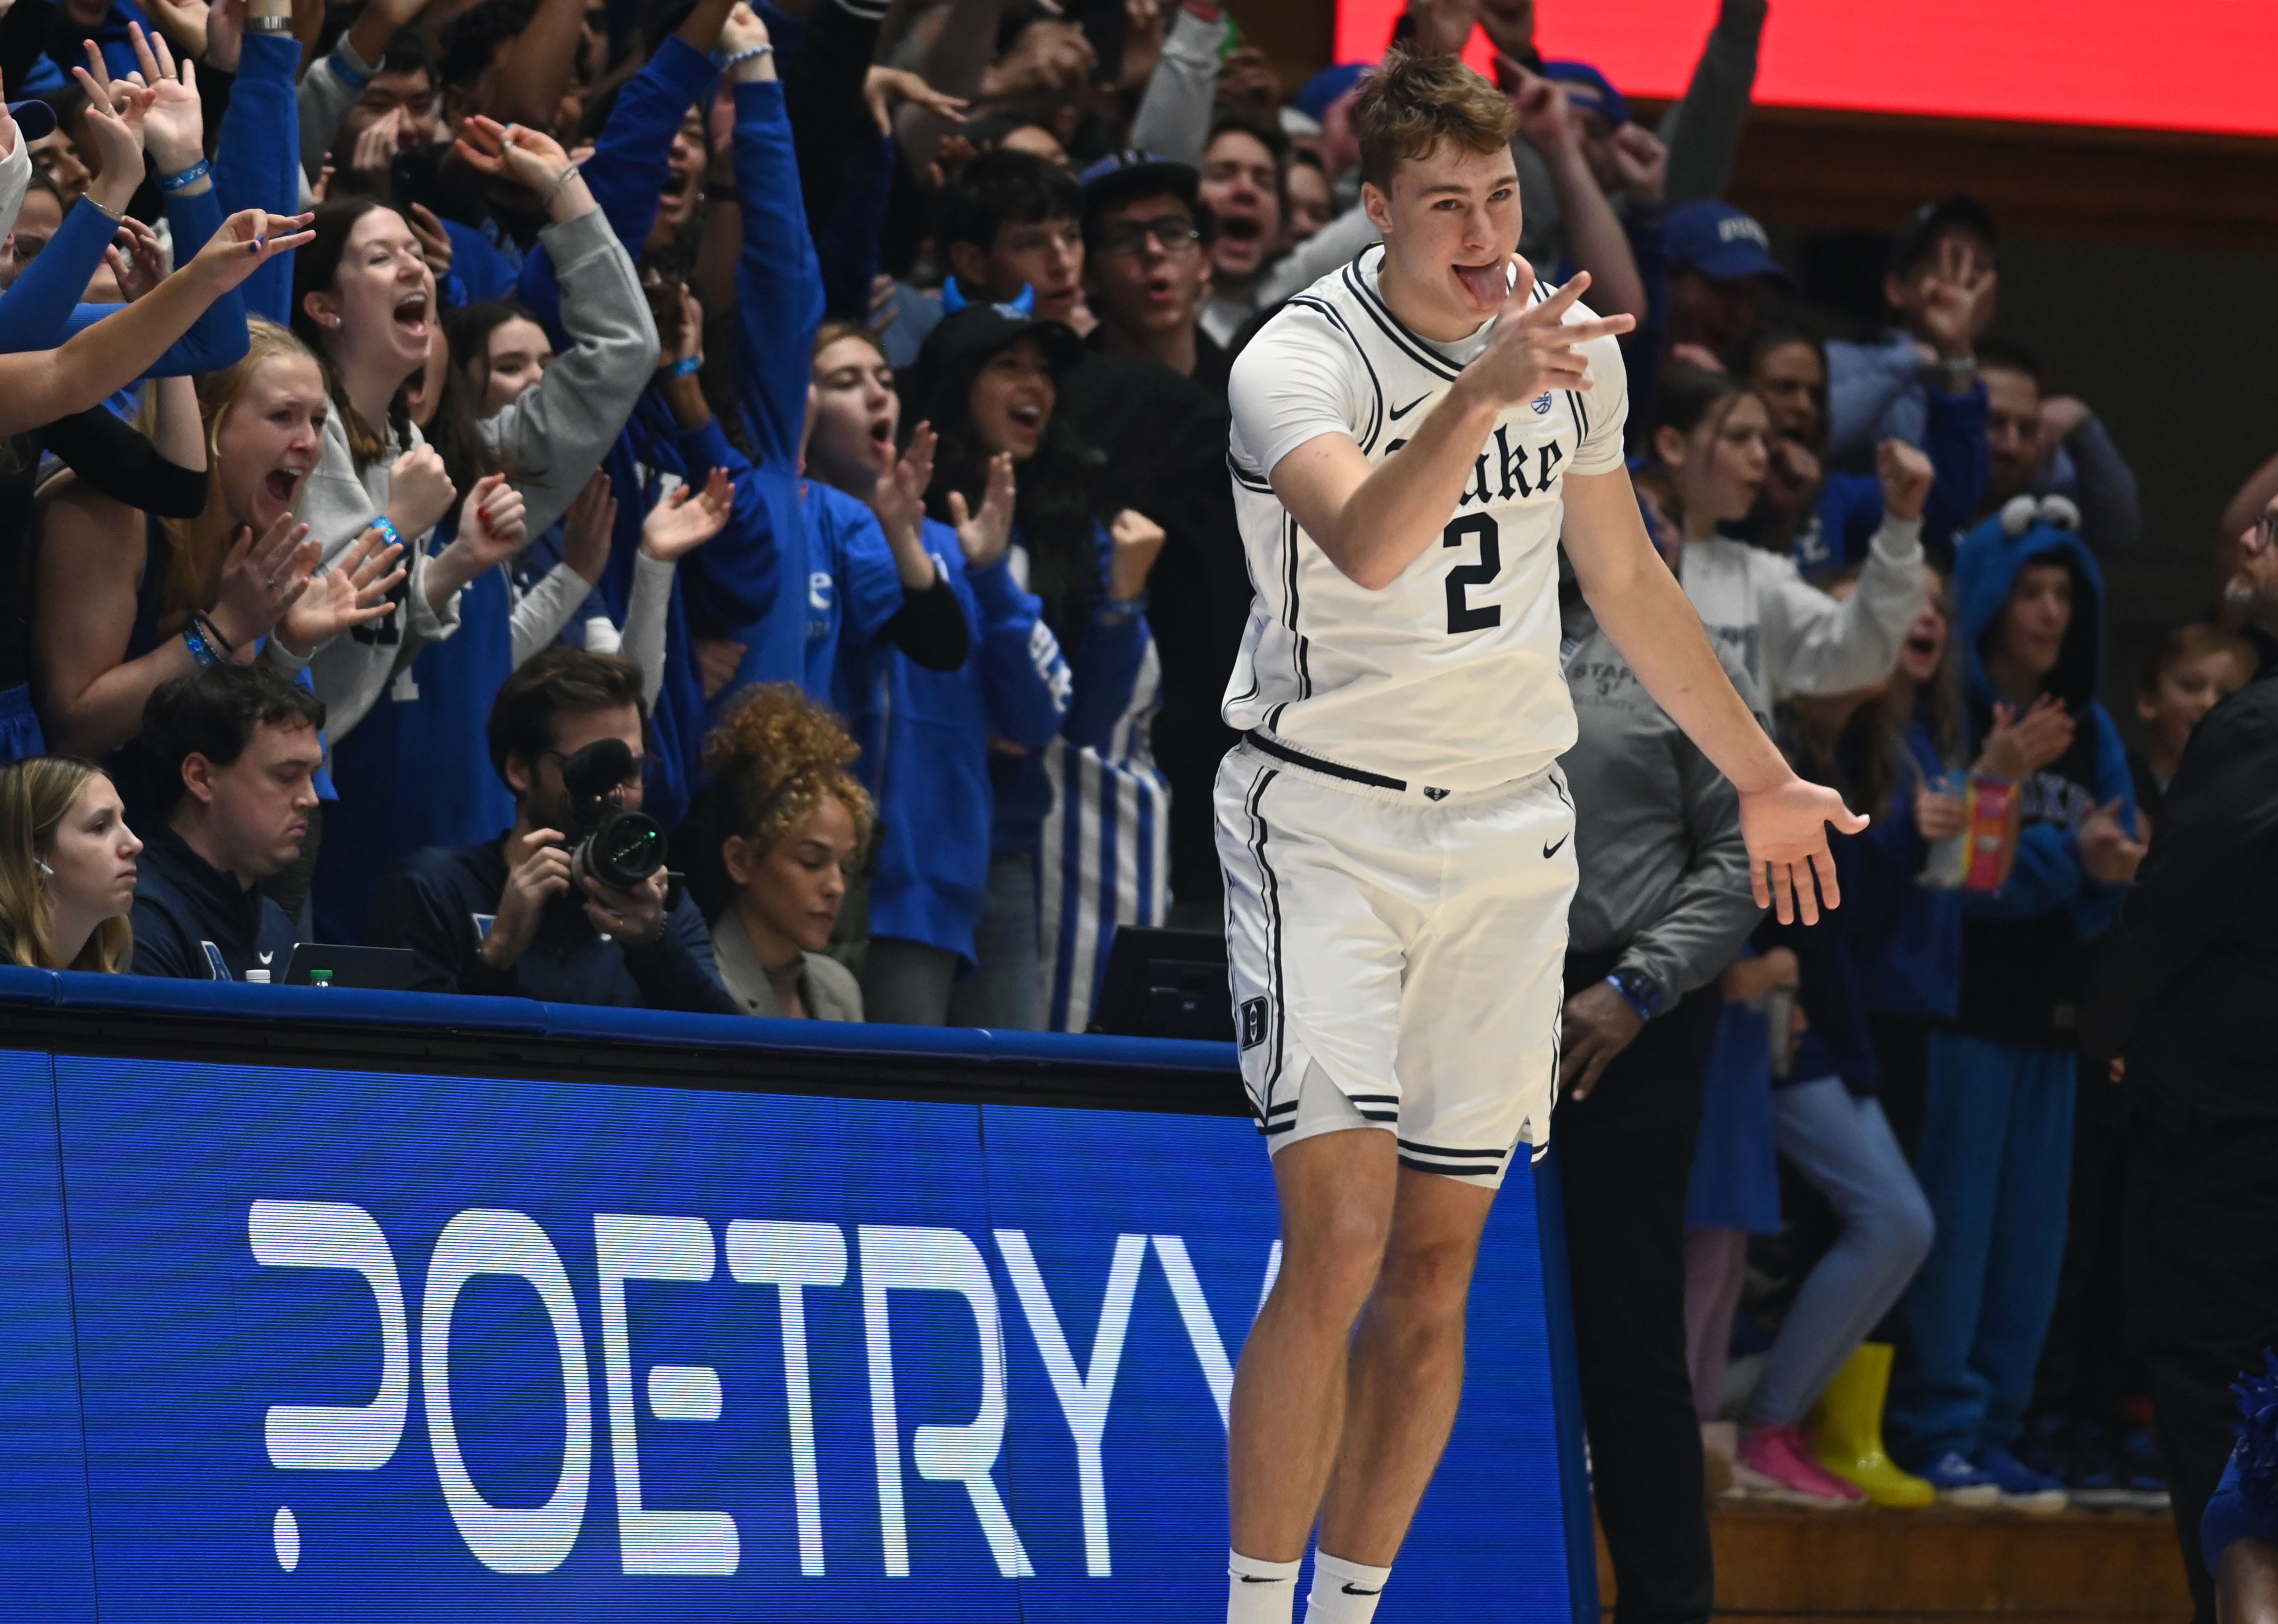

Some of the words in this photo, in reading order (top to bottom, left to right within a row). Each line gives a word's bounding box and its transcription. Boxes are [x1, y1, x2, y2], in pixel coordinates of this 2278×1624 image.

[1385, 423, 1563, 506] uke
[1443, 511, 1501, 634] 2
[1572, 662, 1638, 685] STAF
